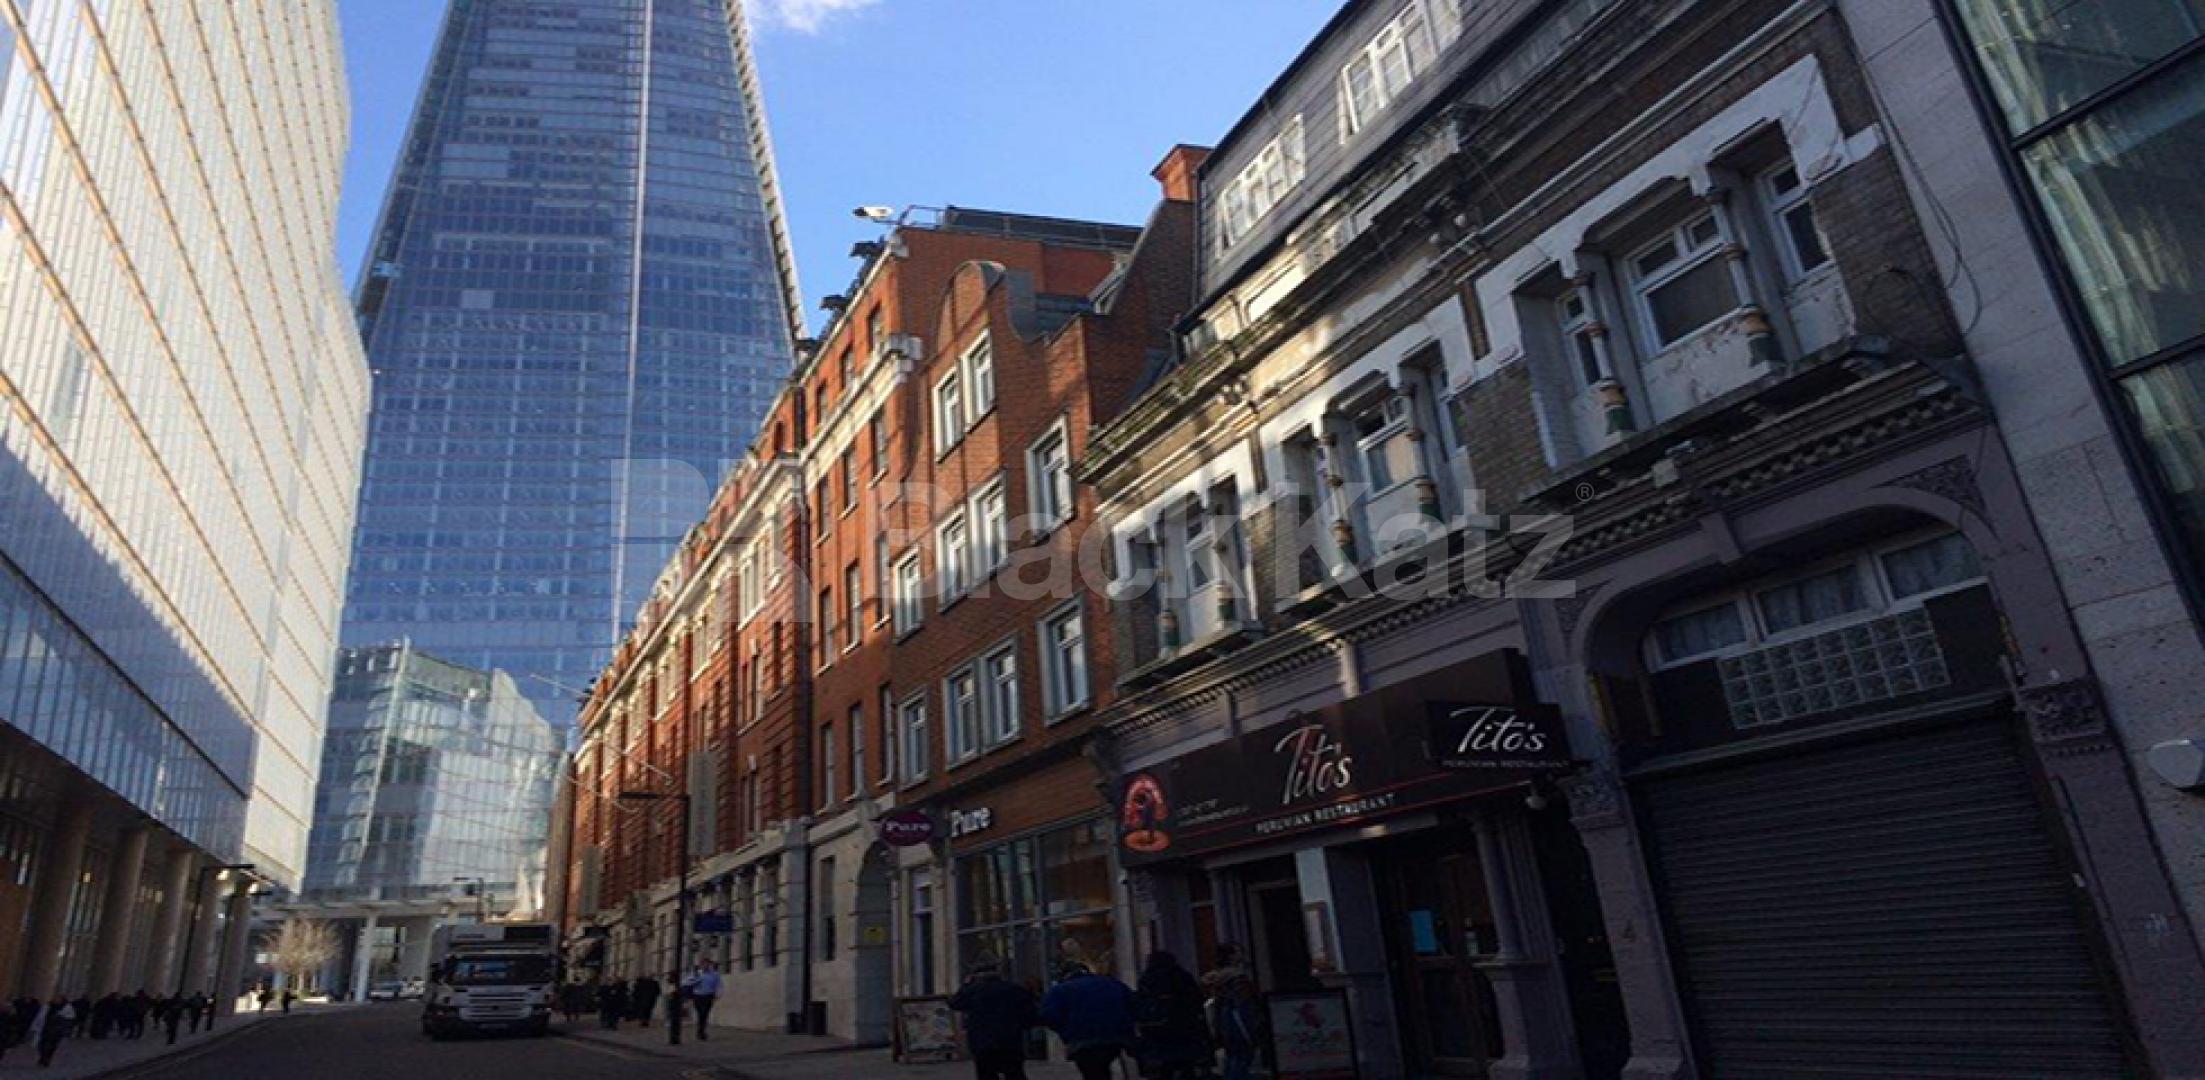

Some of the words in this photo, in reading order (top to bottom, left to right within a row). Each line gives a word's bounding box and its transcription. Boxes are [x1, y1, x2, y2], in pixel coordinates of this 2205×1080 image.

[1448, 706, 1547, 752] Tito's
[1274, 724, 1352, 804] Tito's
[1313, 792, 1395, 820] RESTAURANT
[885, 820, 930, 832] Pure
[951, 807, 991, 838] Pure
